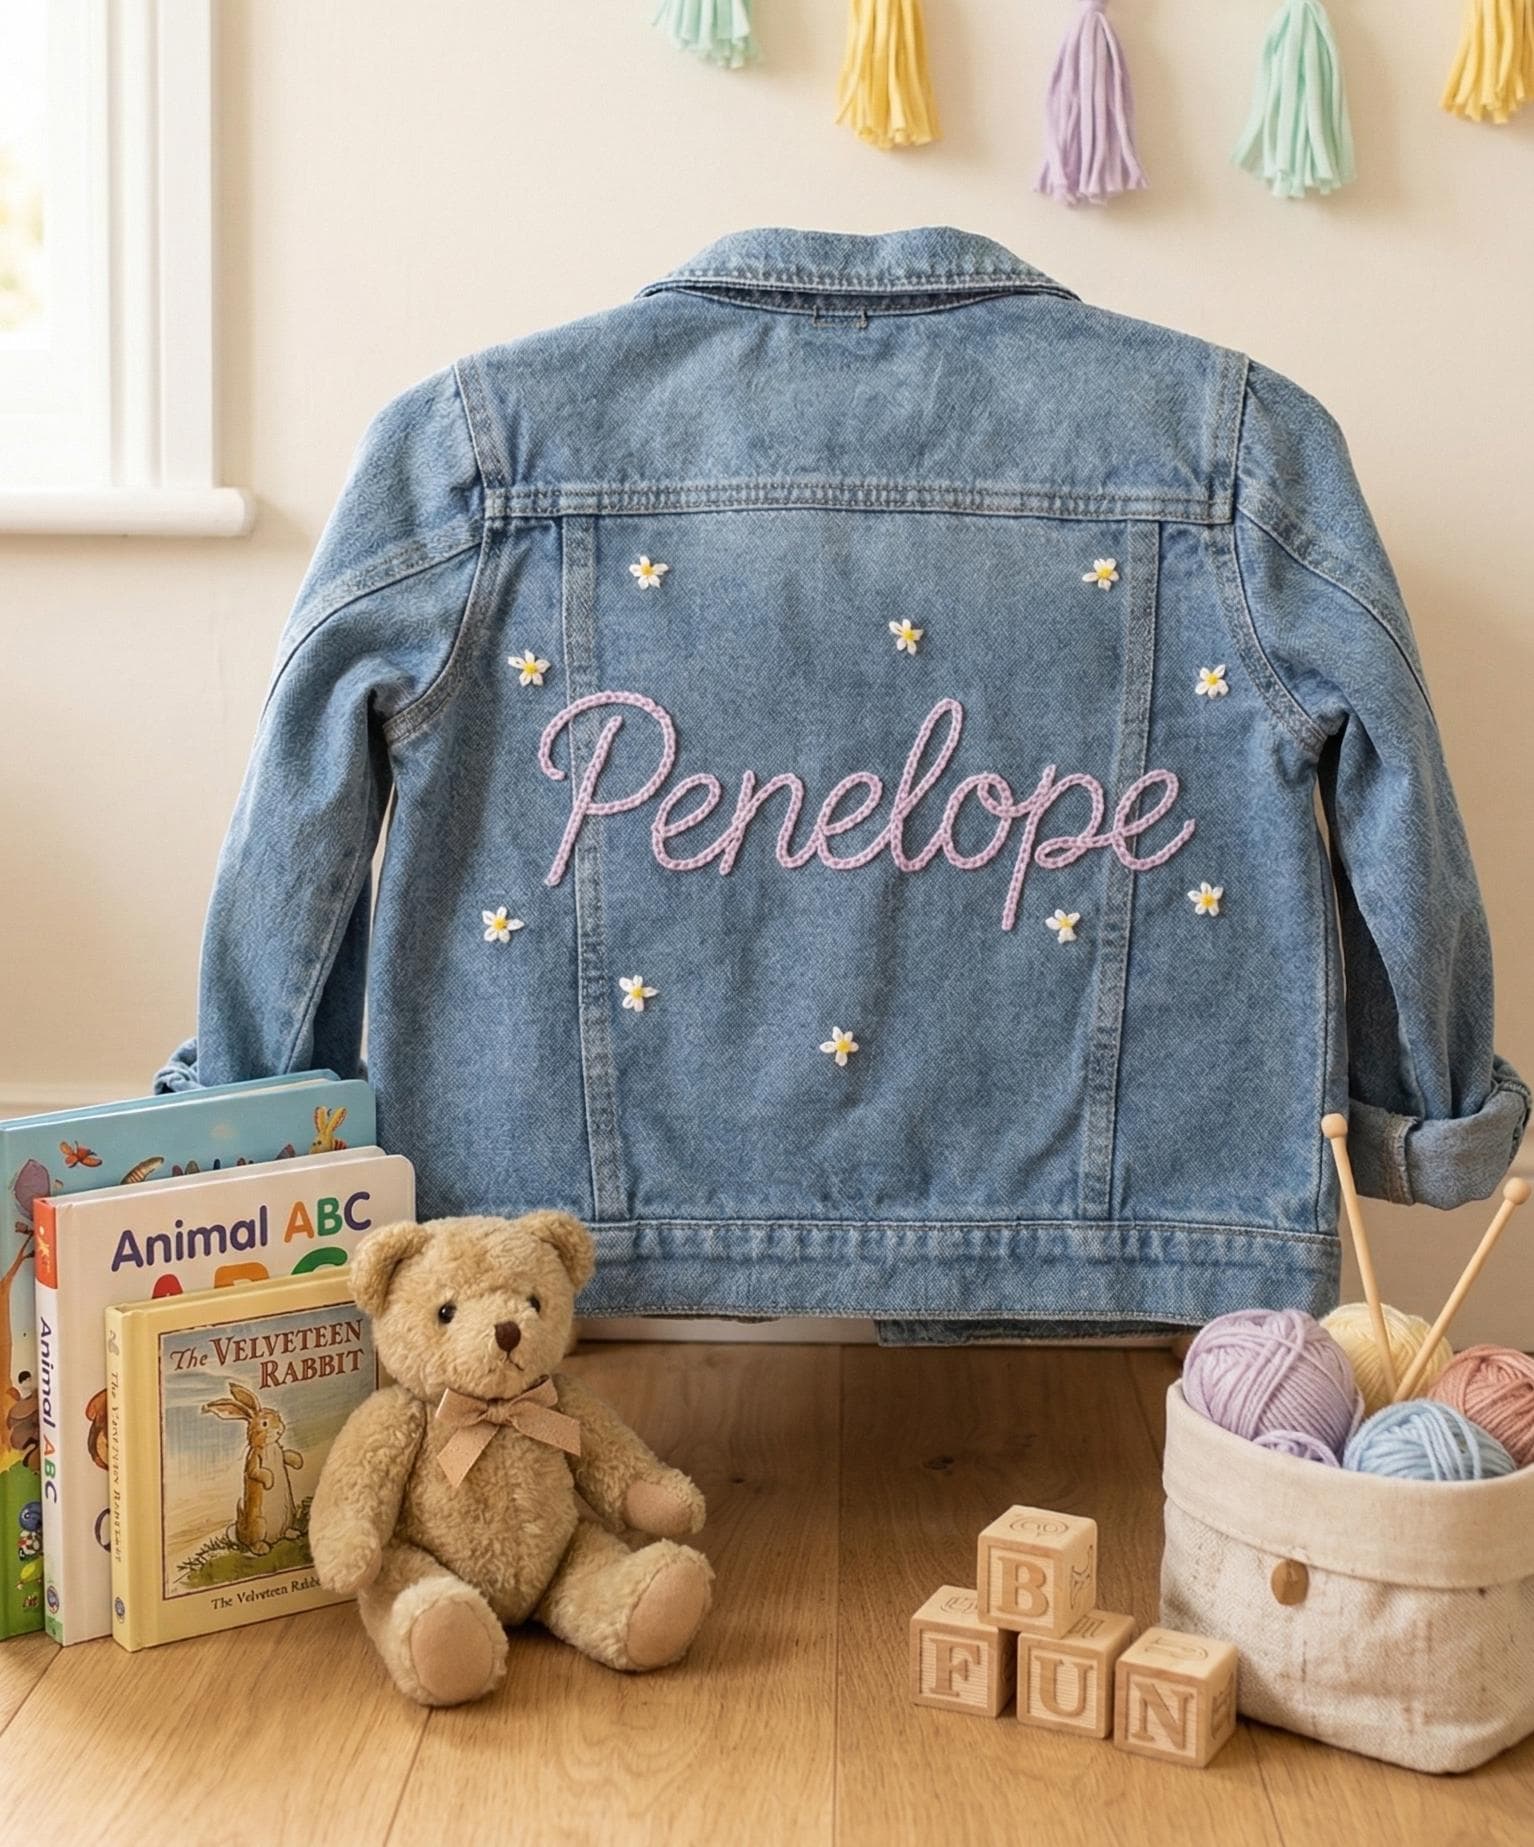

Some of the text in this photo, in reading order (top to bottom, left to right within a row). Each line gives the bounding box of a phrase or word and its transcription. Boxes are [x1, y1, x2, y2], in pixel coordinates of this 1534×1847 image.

[538, 691, 1196, 931] Penelope
[111, 1205, 268, 1272] Animal
[283, 1191, 372, 1243] ABC
[169, 1319, 364, 1371] The VELVETEEN
[259, 1348, 364, 1389] RABBIT
[40, 1317, 58, 1504] Animal ABC
[211, 1597, 232, 1610] The
[997, 1556, 1049, 1617] B
